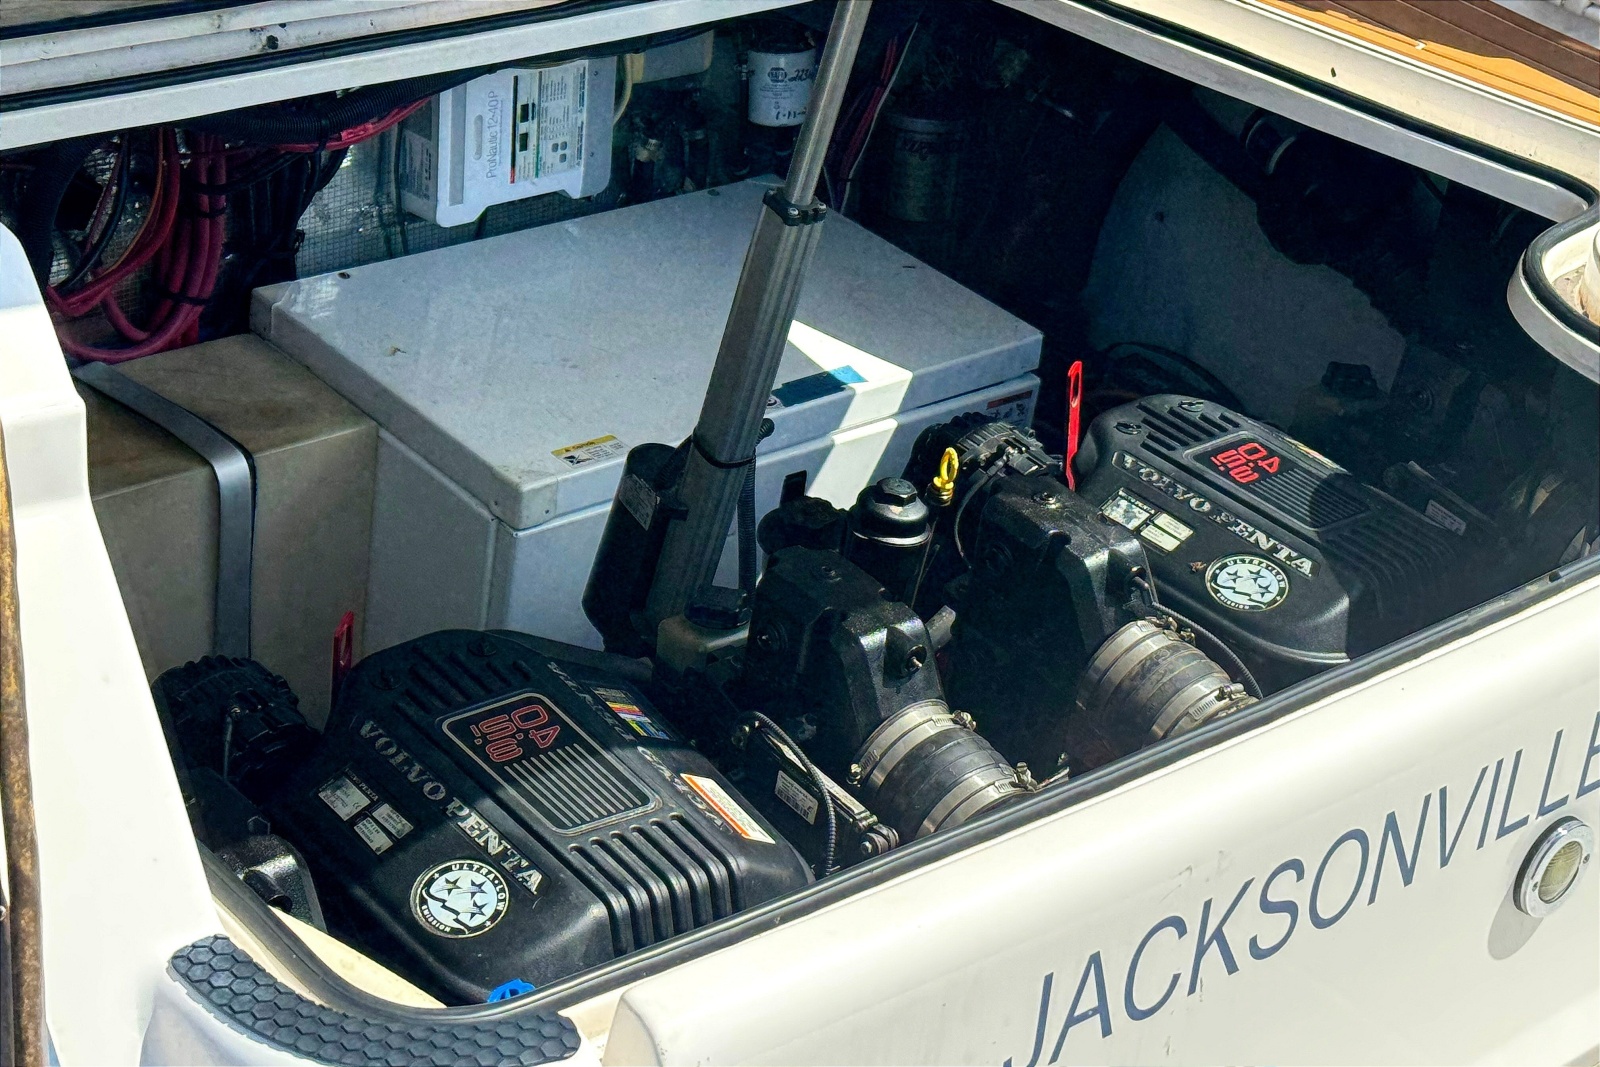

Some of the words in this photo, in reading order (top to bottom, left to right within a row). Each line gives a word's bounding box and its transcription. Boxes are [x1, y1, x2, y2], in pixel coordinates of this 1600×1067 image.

[486, 130, 498, 179] ProNautic
[1122, 453, 1211, 512] VOLVO
[1208, 510, 1314, 577] PENTA
[360, 719, 446, 800] VOLVO
[446, 797, 544, 895] PENTA
[421, 904, 452, 933] EMISSION
[1002, 711, 1600, 1067] JACKSONVILLE
